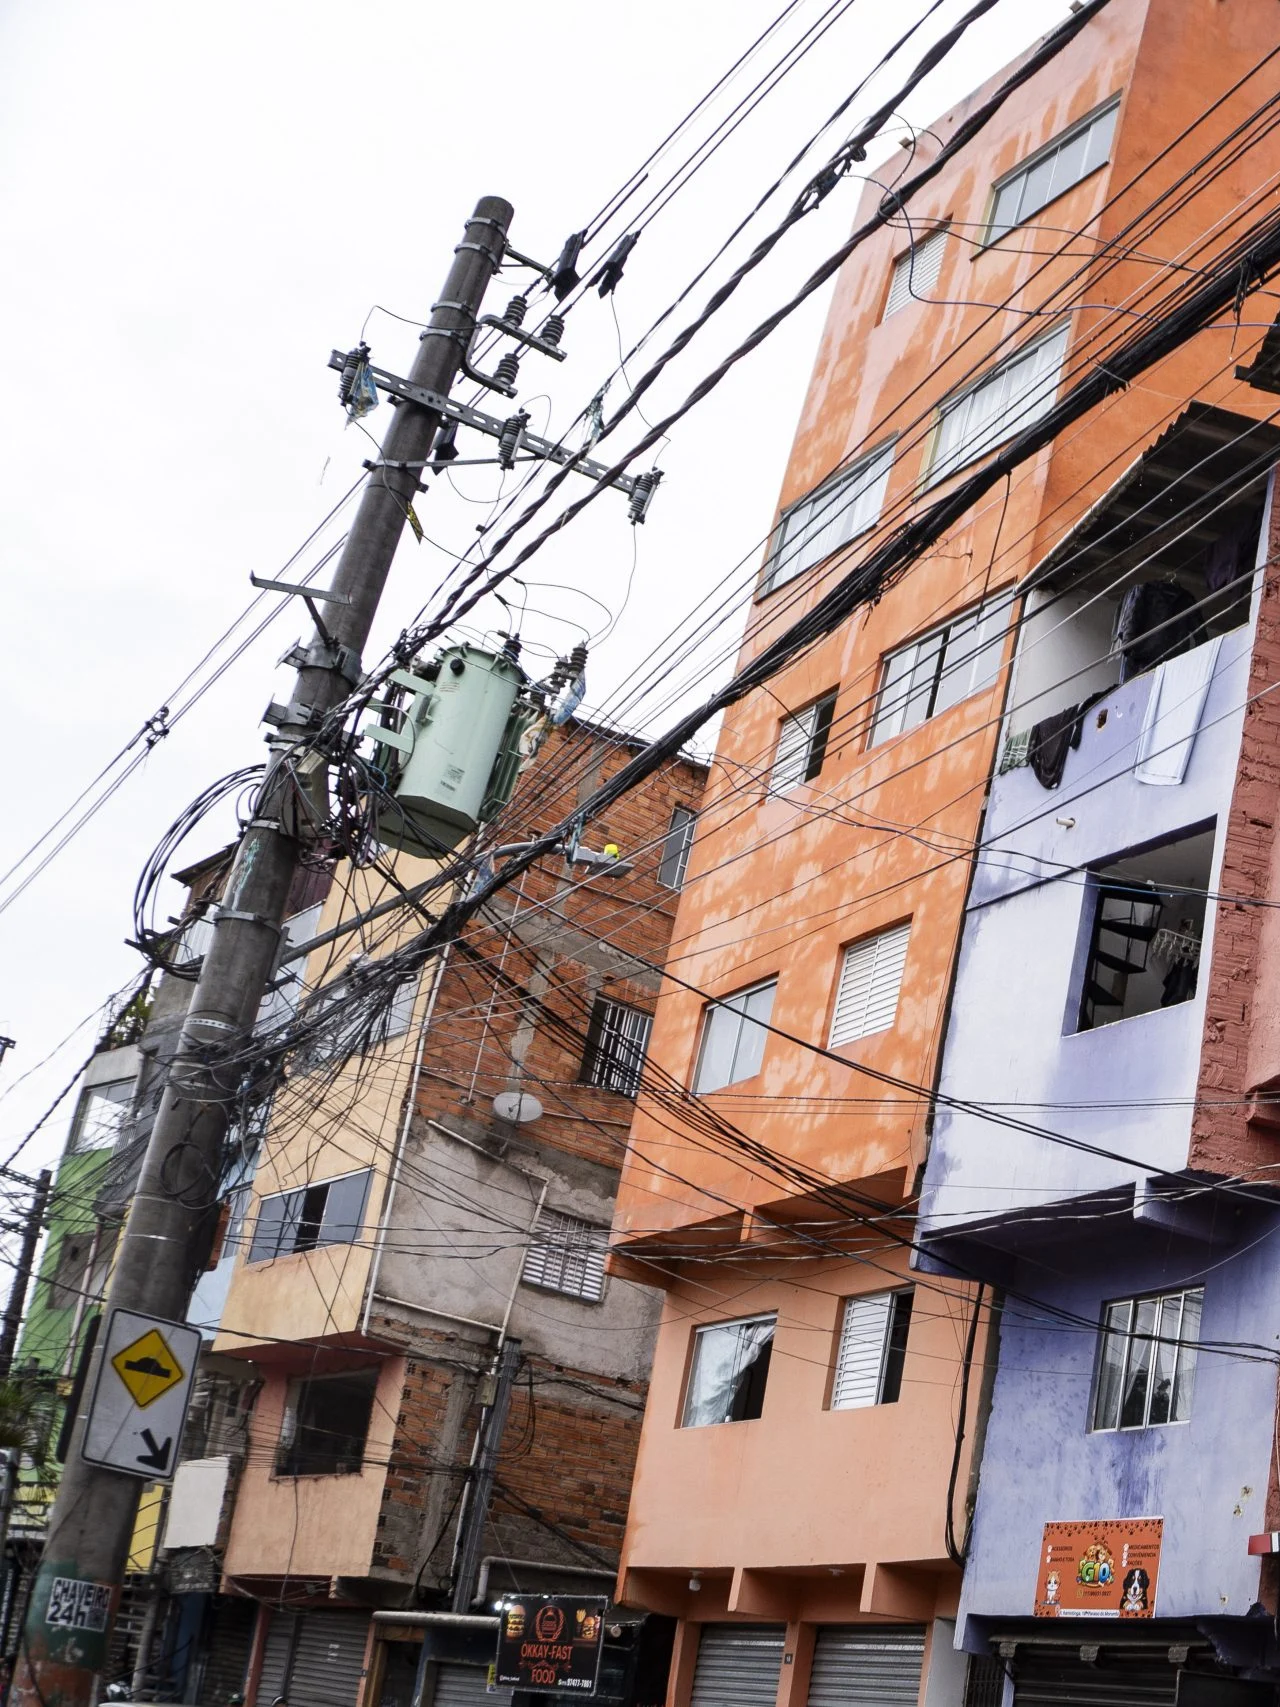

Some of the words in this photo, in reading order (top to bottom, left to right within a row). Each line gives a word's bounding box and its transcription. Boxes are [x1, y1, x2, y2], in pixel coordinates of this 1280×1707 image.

[1081, 1562, 1111, 1583] G10
[53, 1579, 110, 1608] CHAVEIRO
[48, 1600, 86, 1627] 24h
[531, 1668, 556, 1684] FOOD
